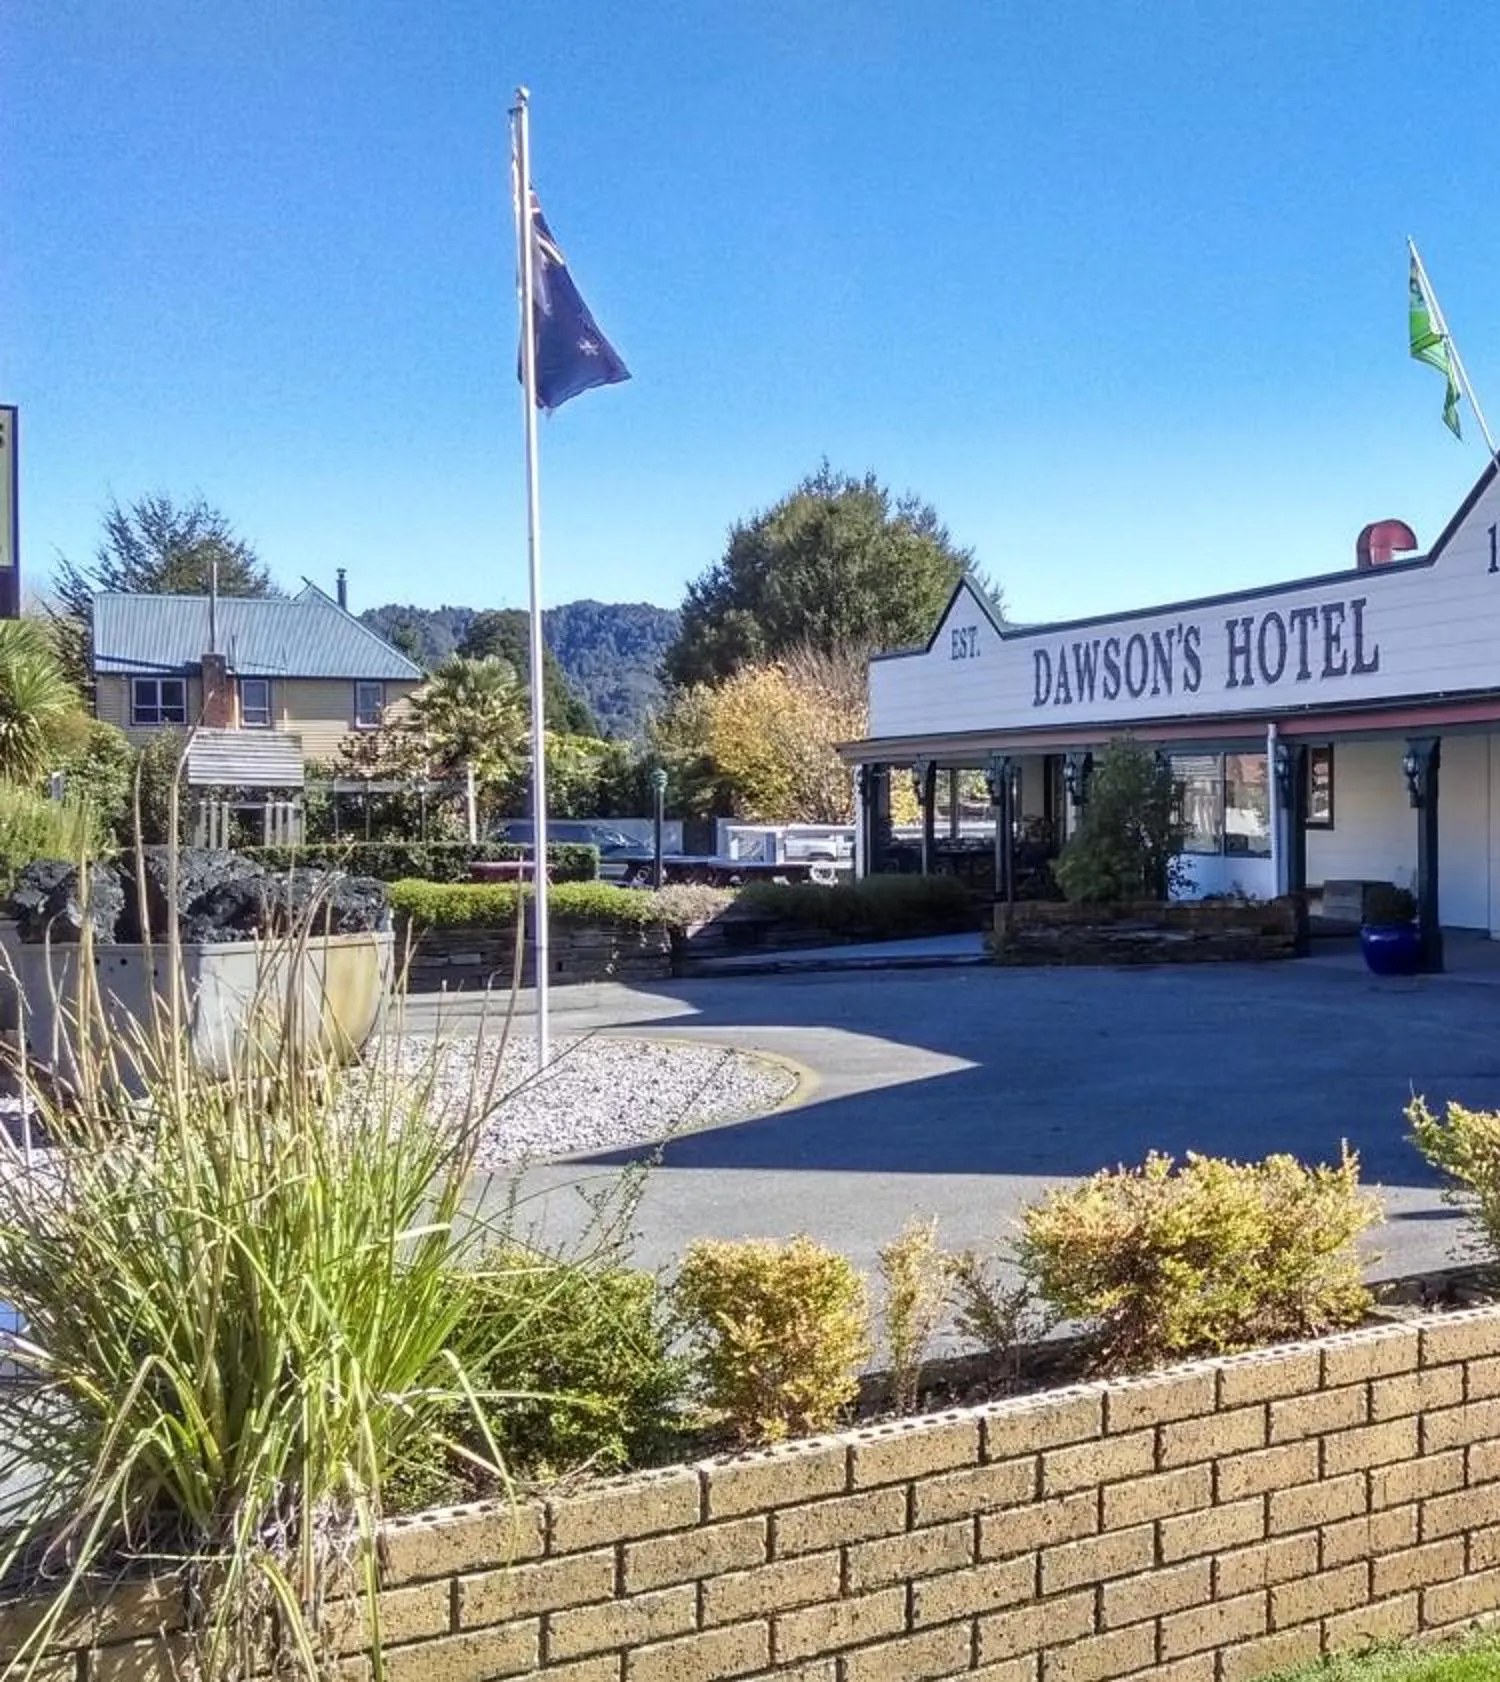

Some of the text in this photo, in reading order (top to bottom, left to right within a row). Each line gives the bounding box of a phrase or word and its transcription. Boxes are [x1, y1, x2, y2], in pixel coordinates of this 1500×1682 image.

[950, 625, 981, 660] EST.
[1033, 598, 1379, 707] DAWSON'S HOTEL
